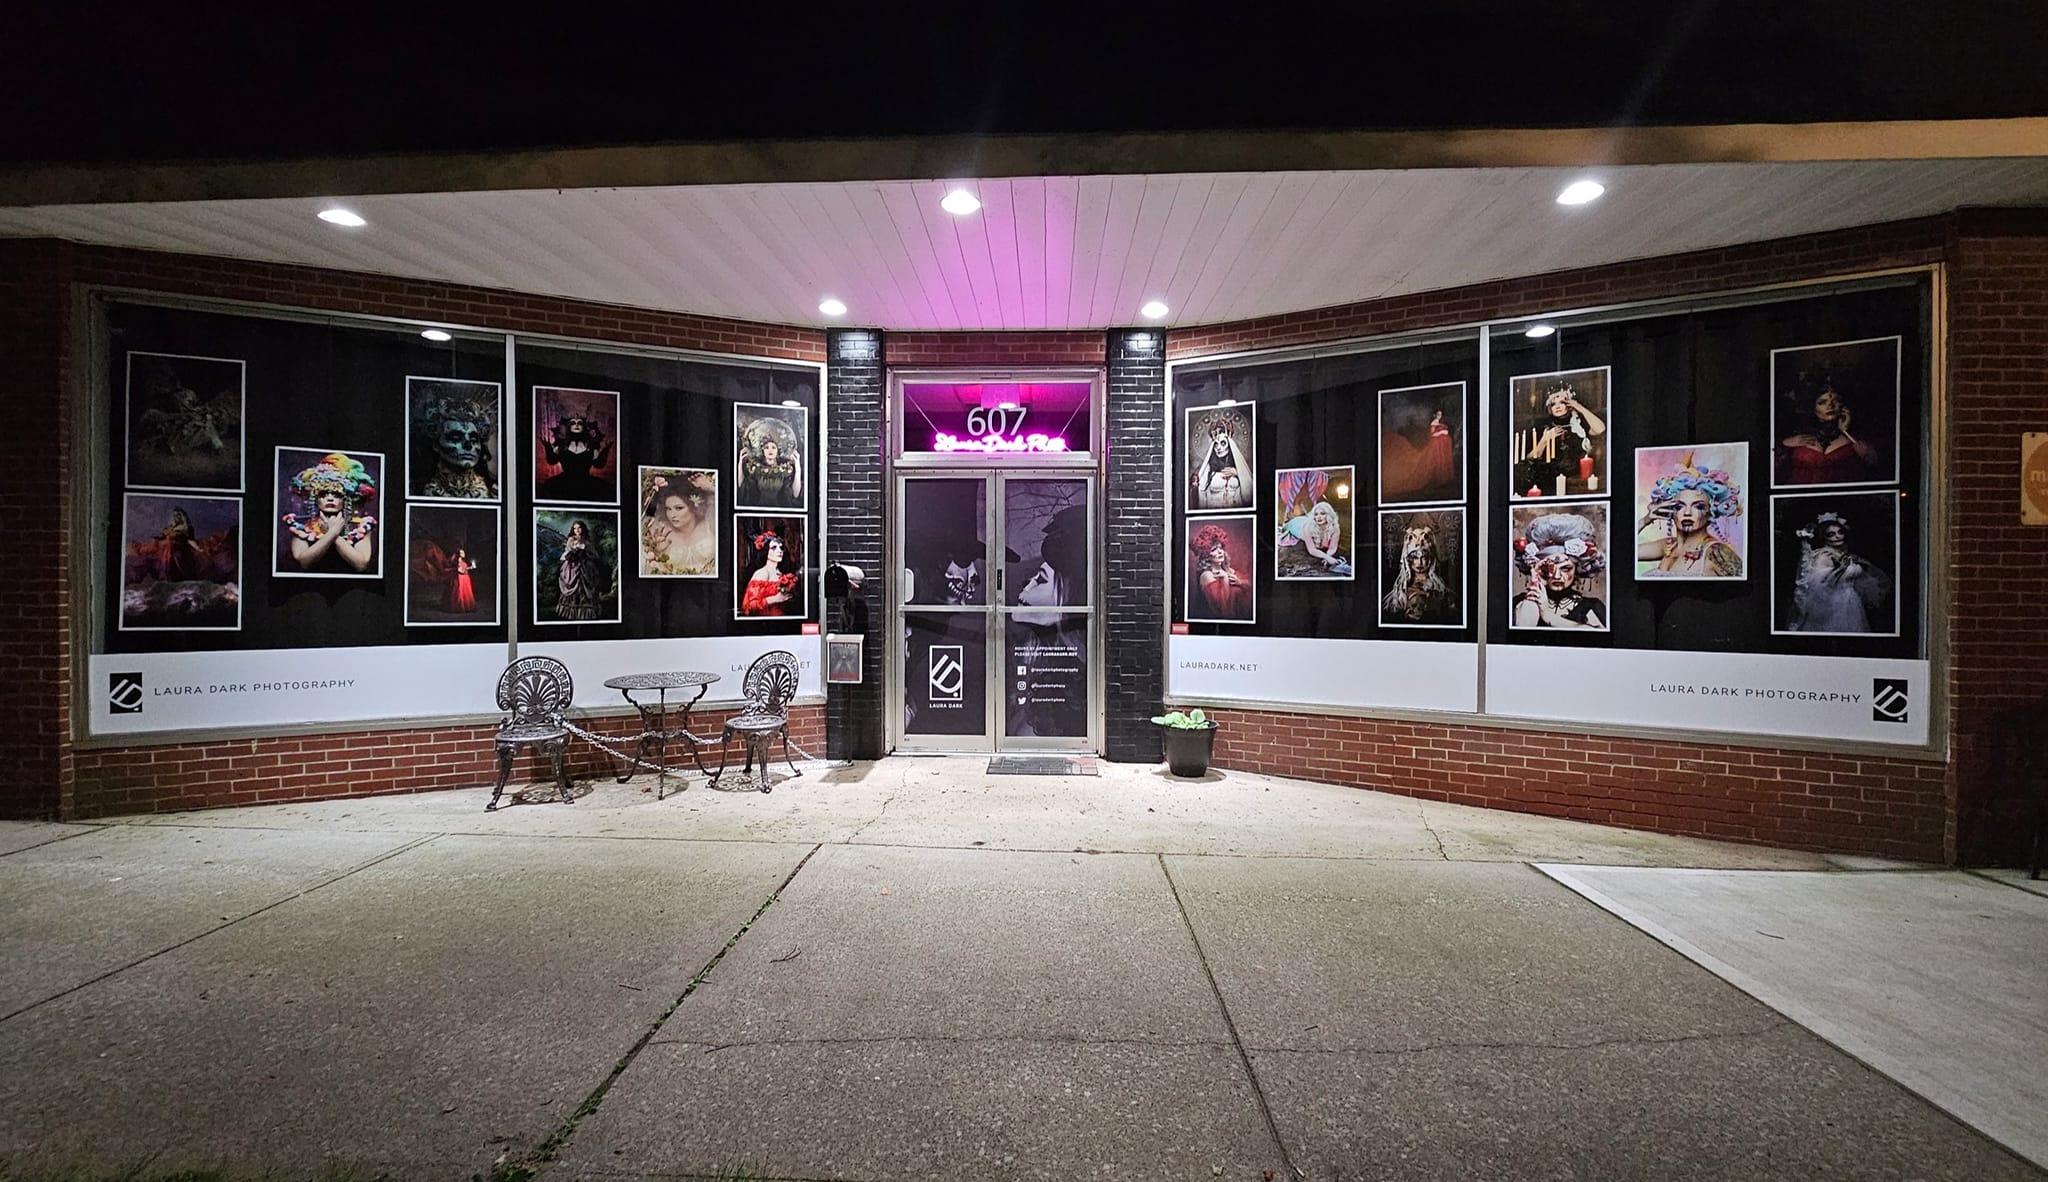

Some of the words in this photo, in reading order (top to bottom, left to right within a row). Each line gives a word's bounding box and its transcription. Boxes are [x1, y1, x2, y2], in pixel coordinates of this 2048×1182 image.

[967, 407, 1027, 436] 607
[1180, 661, 1259, 672] LAURADARK.NET
[154, 686, 203, 696] LAURA
[209, 683, 248, 694] DARK
[253, 679, 356, 692] PHOTOGRAPHY
[1650, 683, 1695, 695] LAURA
[1701, 686, 1739, 697] DARK
[1745, 688, 1862, 704] PHOTOGRAPHY
